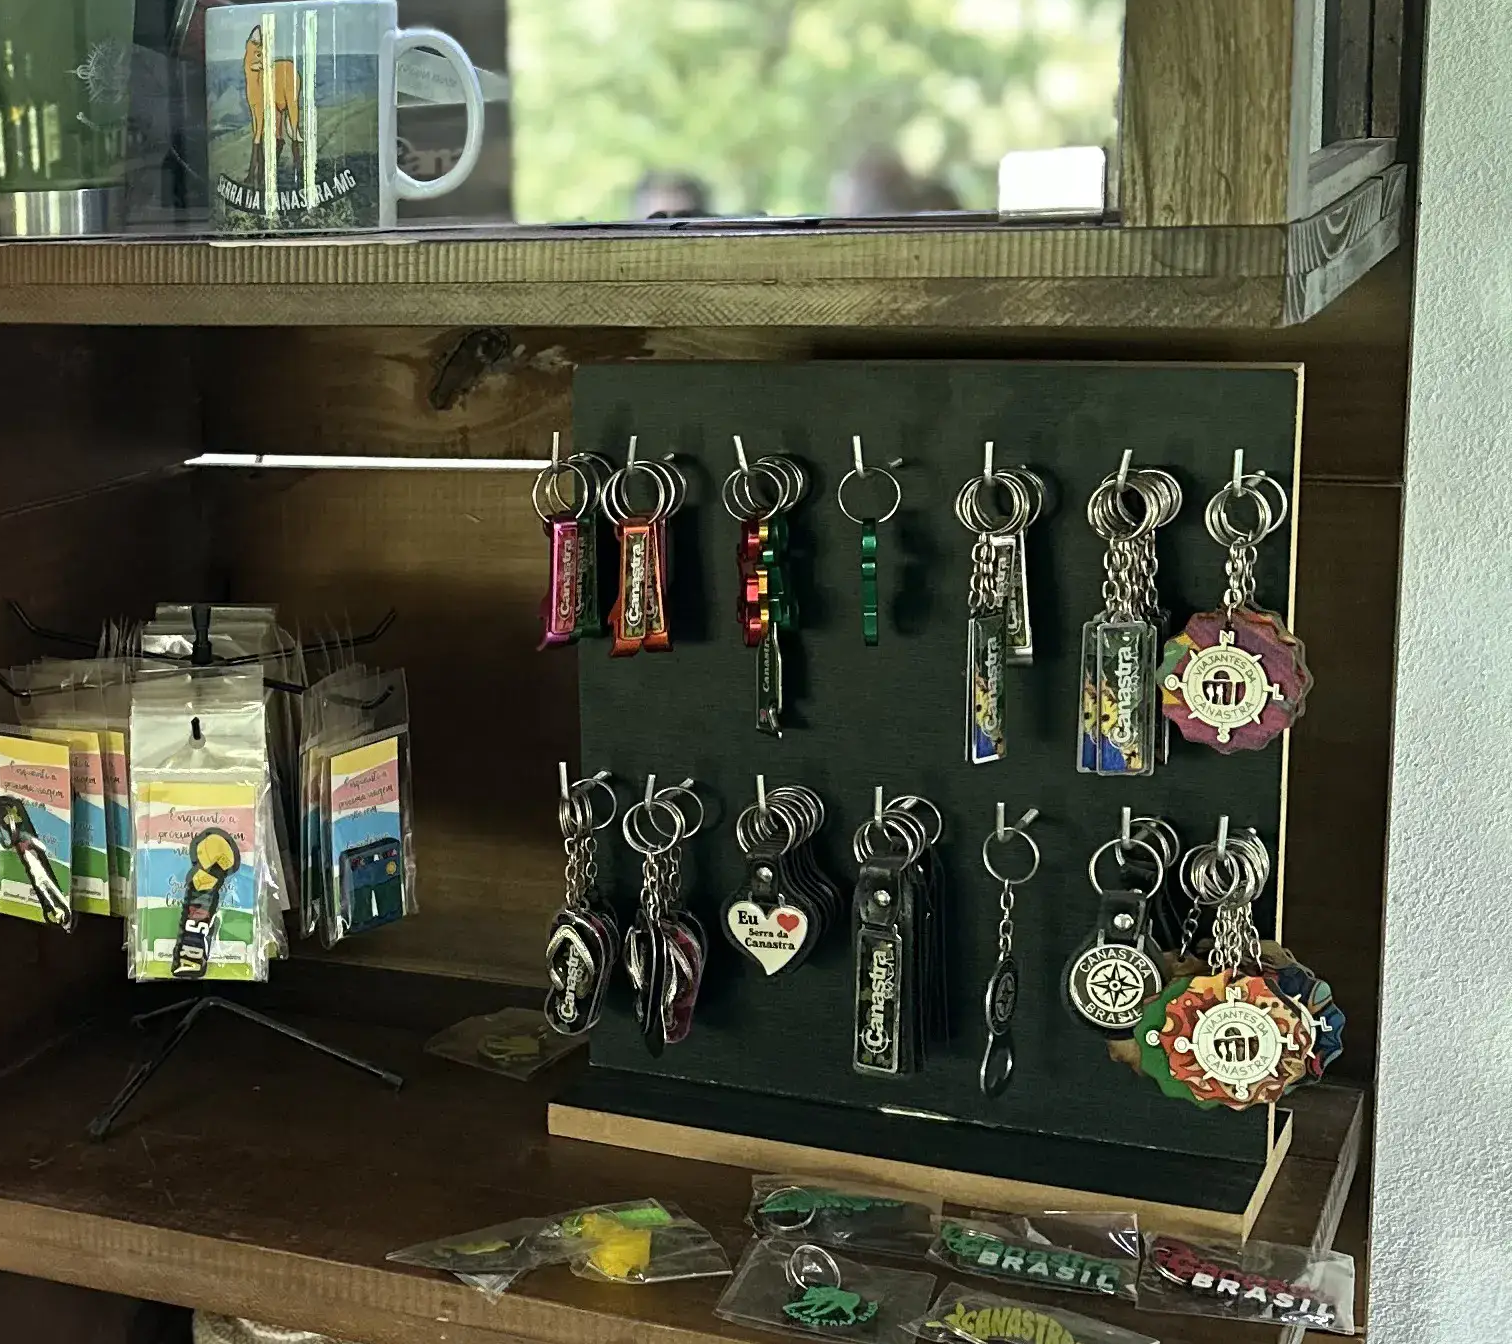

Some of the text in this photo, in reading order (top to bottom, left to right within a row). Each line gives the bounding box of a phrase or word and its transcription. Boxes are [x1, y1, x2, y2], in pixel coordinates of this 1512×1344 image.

[217, 169, 356, 212] SERRA DA ANASRA-MG
[628, 543, 642, 623] Canastra
[1219, 629, 1235, 644] N
[1194, 654, 1257, 684] VIAJANTES DA
[983, 636, 1000, 732] Canastra
[1114, 646, 1133, 744] Canastra
[1193, 693, 1255, 720] CANASTRA
[169, 807, 225, 827] Enquanto
[738, 910, 759, 925] Eu
[745, 937, 796, 950] Canastra
[748, 927, 789, 939] Serra da
[1079, 948, 1153, 979] CANASTRA
[865, 950, 888, 1047] Canastra
[1226, 987, 1241, 1000] N
[1085, 1003, 1143, 1023] BRASIL
[1203, 1011, 1269, 1038] VIAJANTES DA
[1205, 1052, 1271, 1076] CANASTRA
[977, 1250, 1115, 1291] BRASIL
[1191, 1272, 1335, 1324] BRASIL
